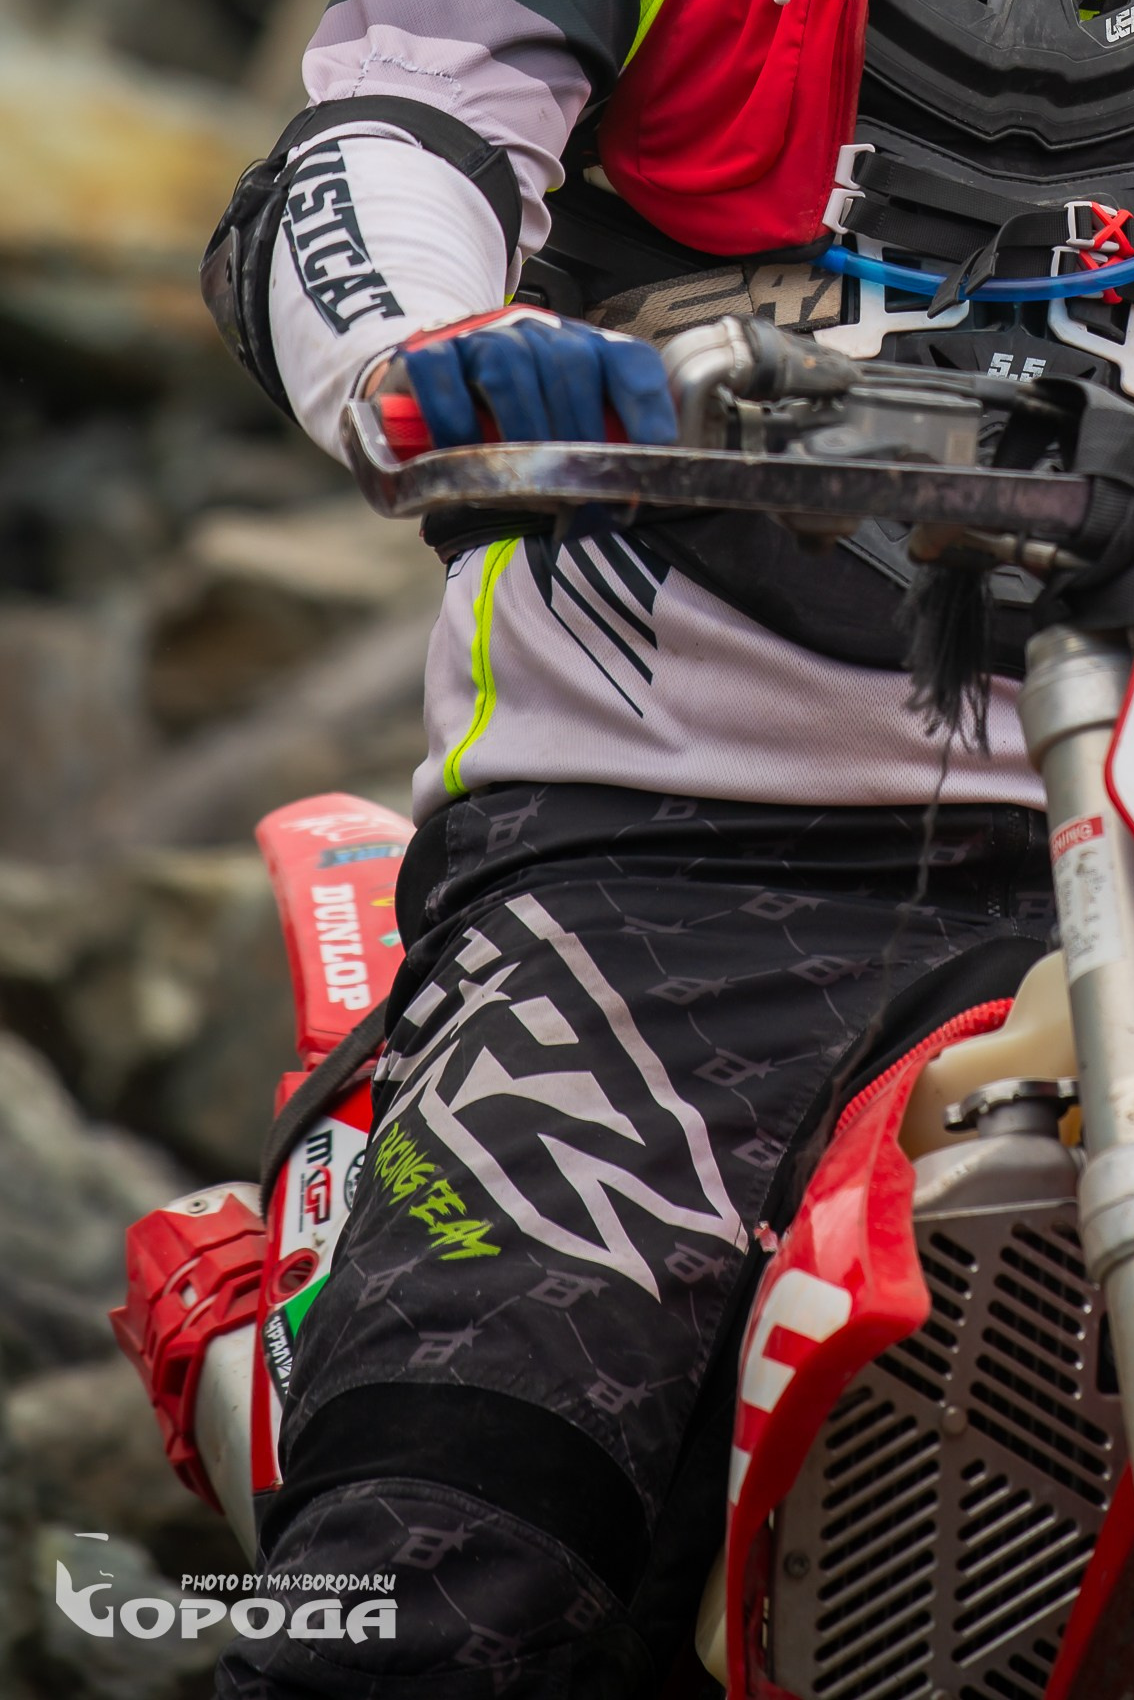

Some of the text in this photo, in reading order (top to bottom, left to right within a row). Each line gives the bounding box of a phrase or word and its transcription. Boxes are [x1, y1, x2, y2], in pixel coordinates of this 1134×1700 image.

[986, 352, 1047, 383] 5.5
[311, 882, 371, 1011] DUNLOP
[408, 1179, 502, 1261] TEAM
